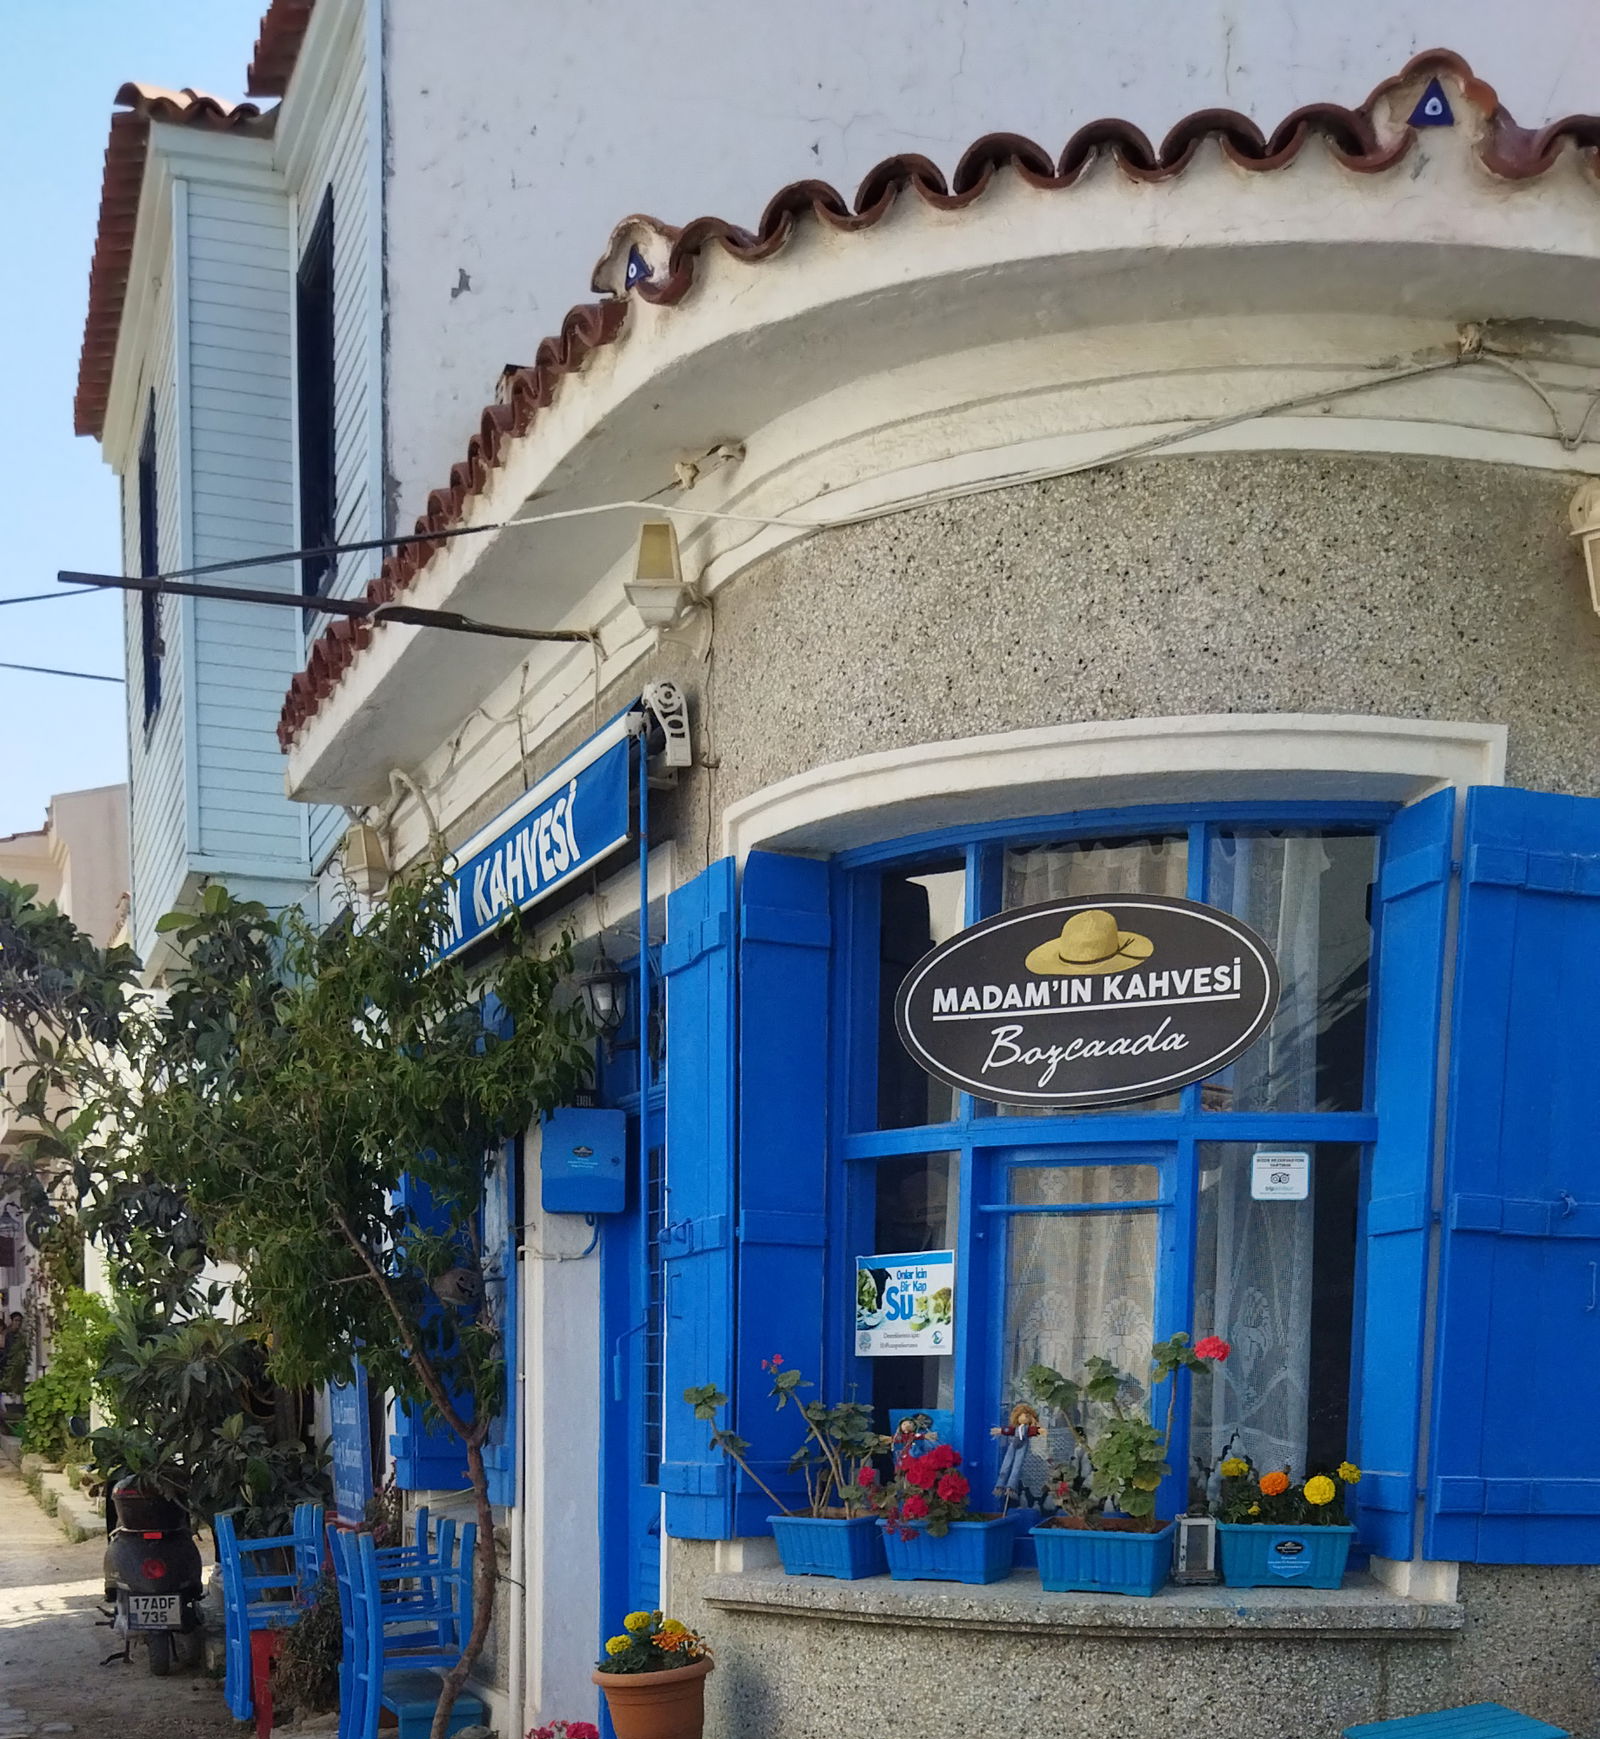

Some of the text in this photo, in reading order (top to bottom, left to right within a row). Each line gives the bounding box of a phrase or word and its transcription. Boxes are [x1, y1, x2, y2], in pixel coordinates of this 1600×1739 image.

[473, 778, 581, 928] KAHVESİ
[932, 956, 1242, 1014] MADAM'IN KAHVESİ
[981, 1016, 1190, 1088] Bozcaada
[900, 1281, 927, 1293] Bir Kap
[142, 1611, 168, 1623] 735
